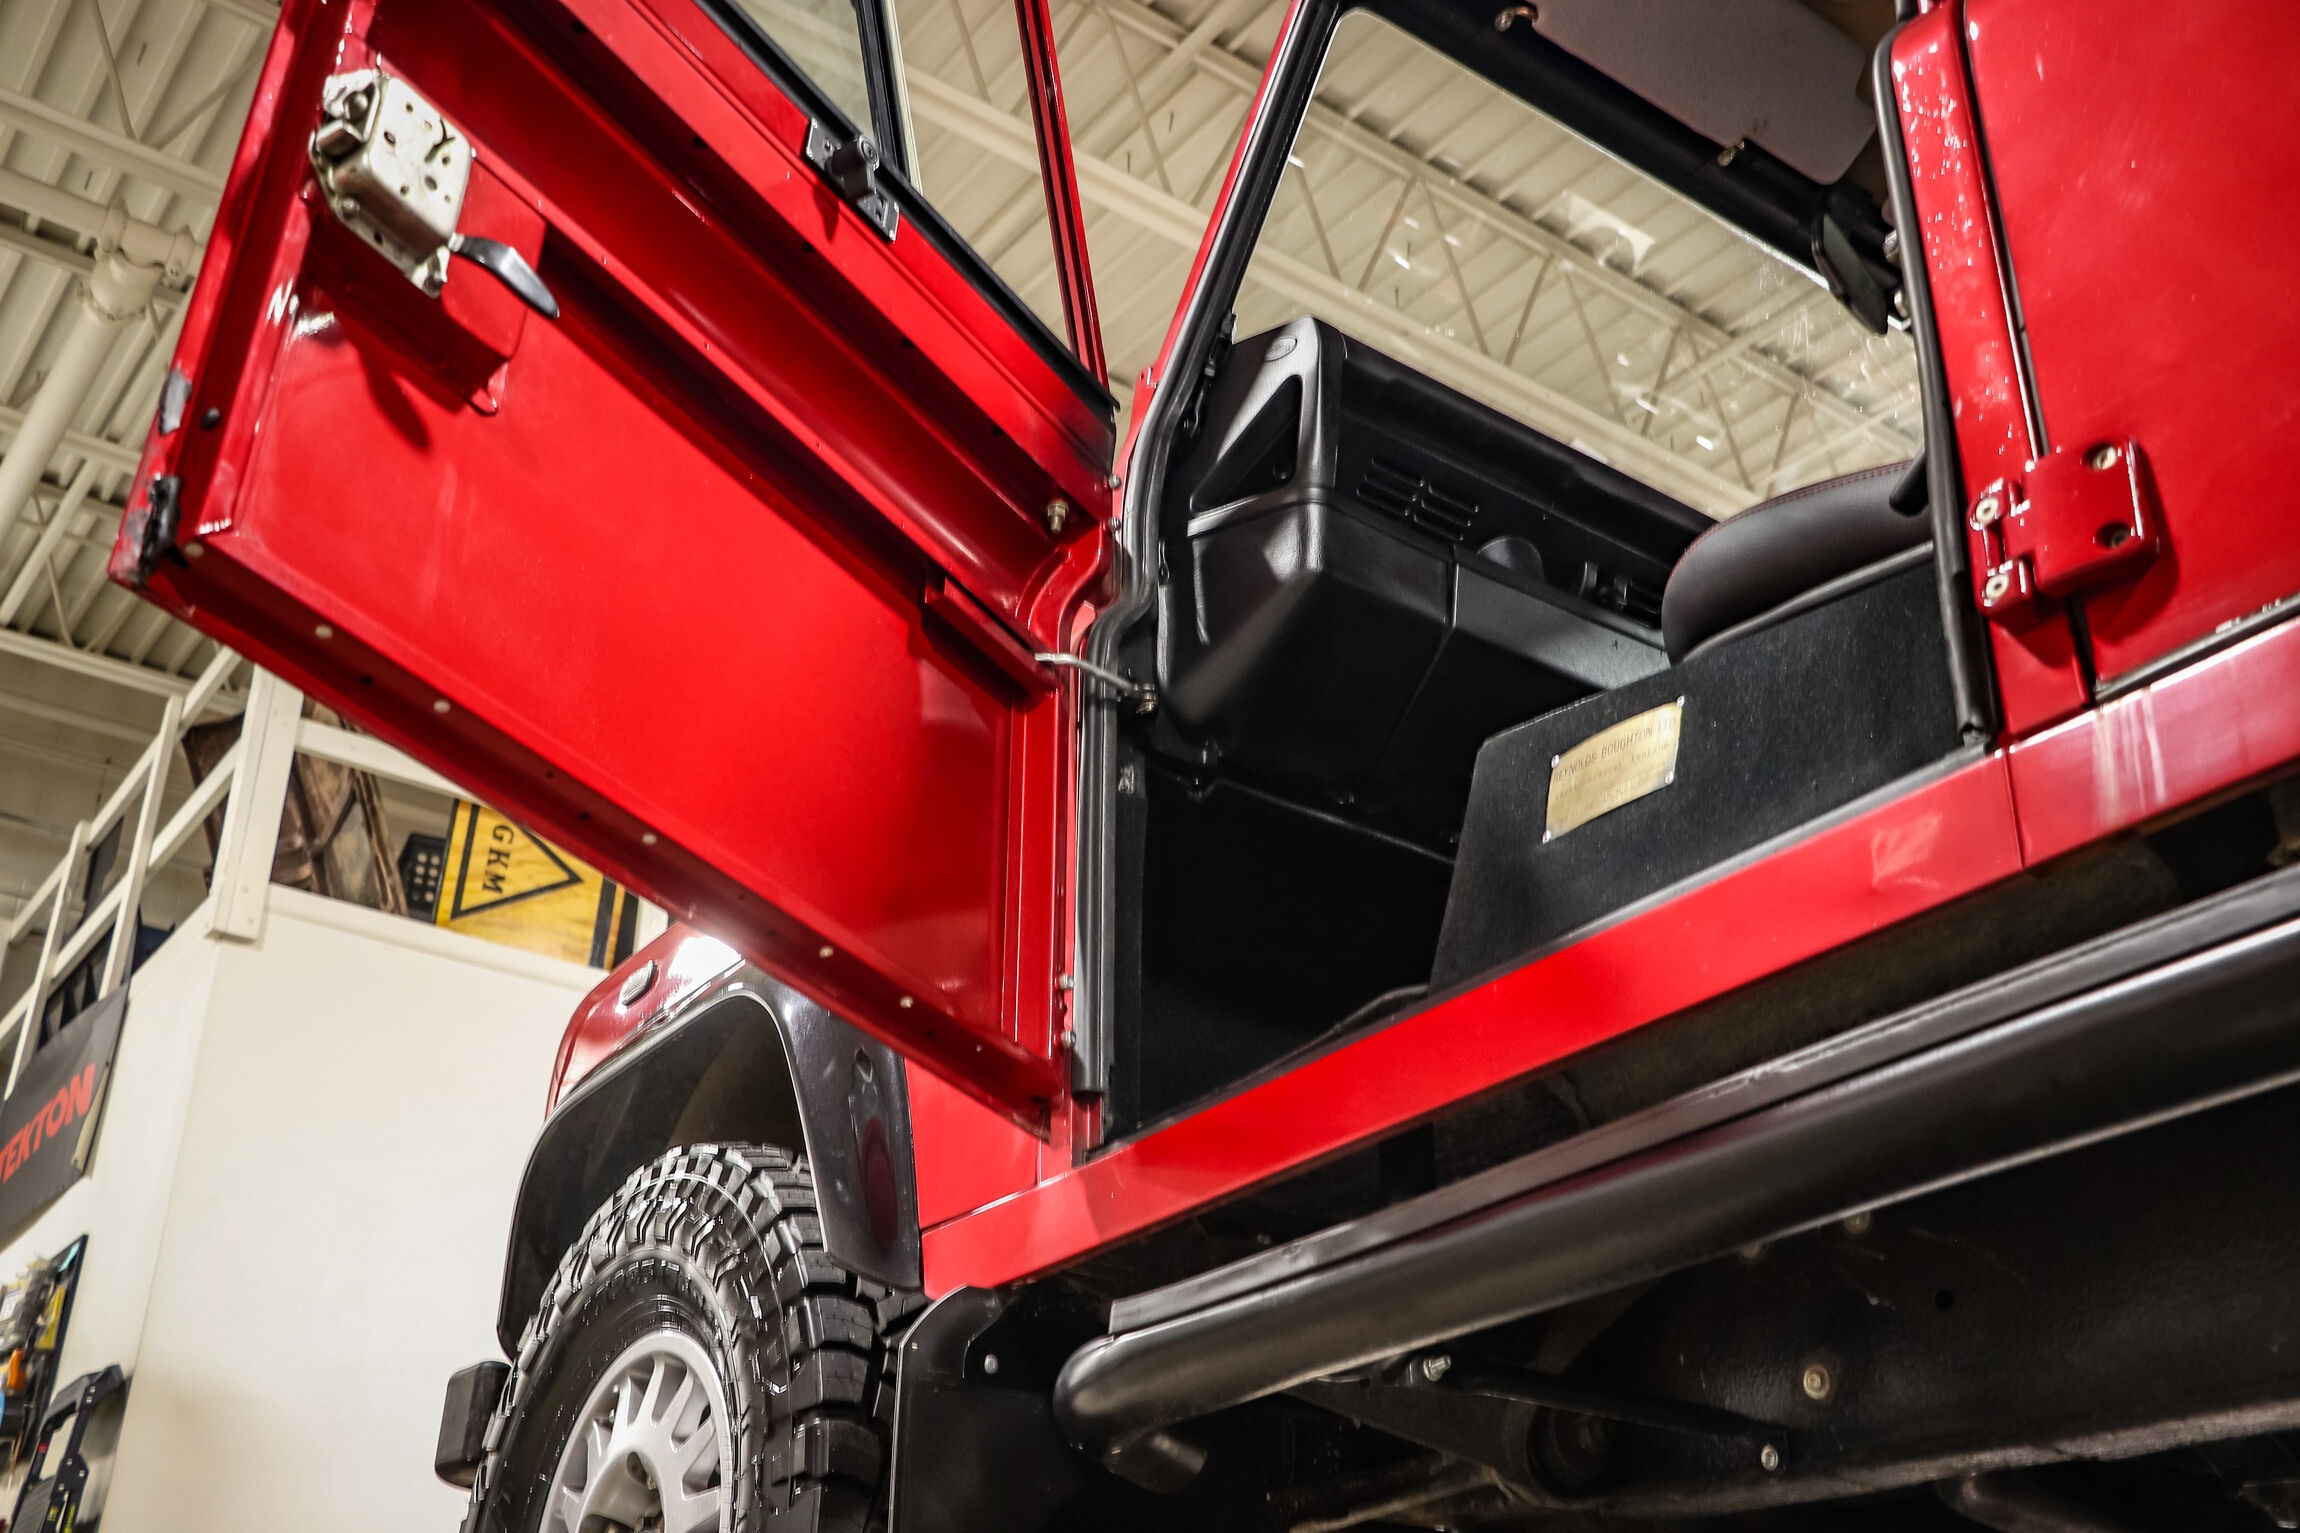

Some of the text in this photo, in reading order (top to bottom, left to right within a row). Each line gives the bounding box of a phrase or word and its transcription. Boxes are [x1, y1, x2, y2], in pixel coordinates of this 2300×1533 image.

[1553, 753, 1597, 783] REYNOLDS
[1601, 725, 1654, 759] BOUGHTON
[482, 825, 514, 894] GKM
